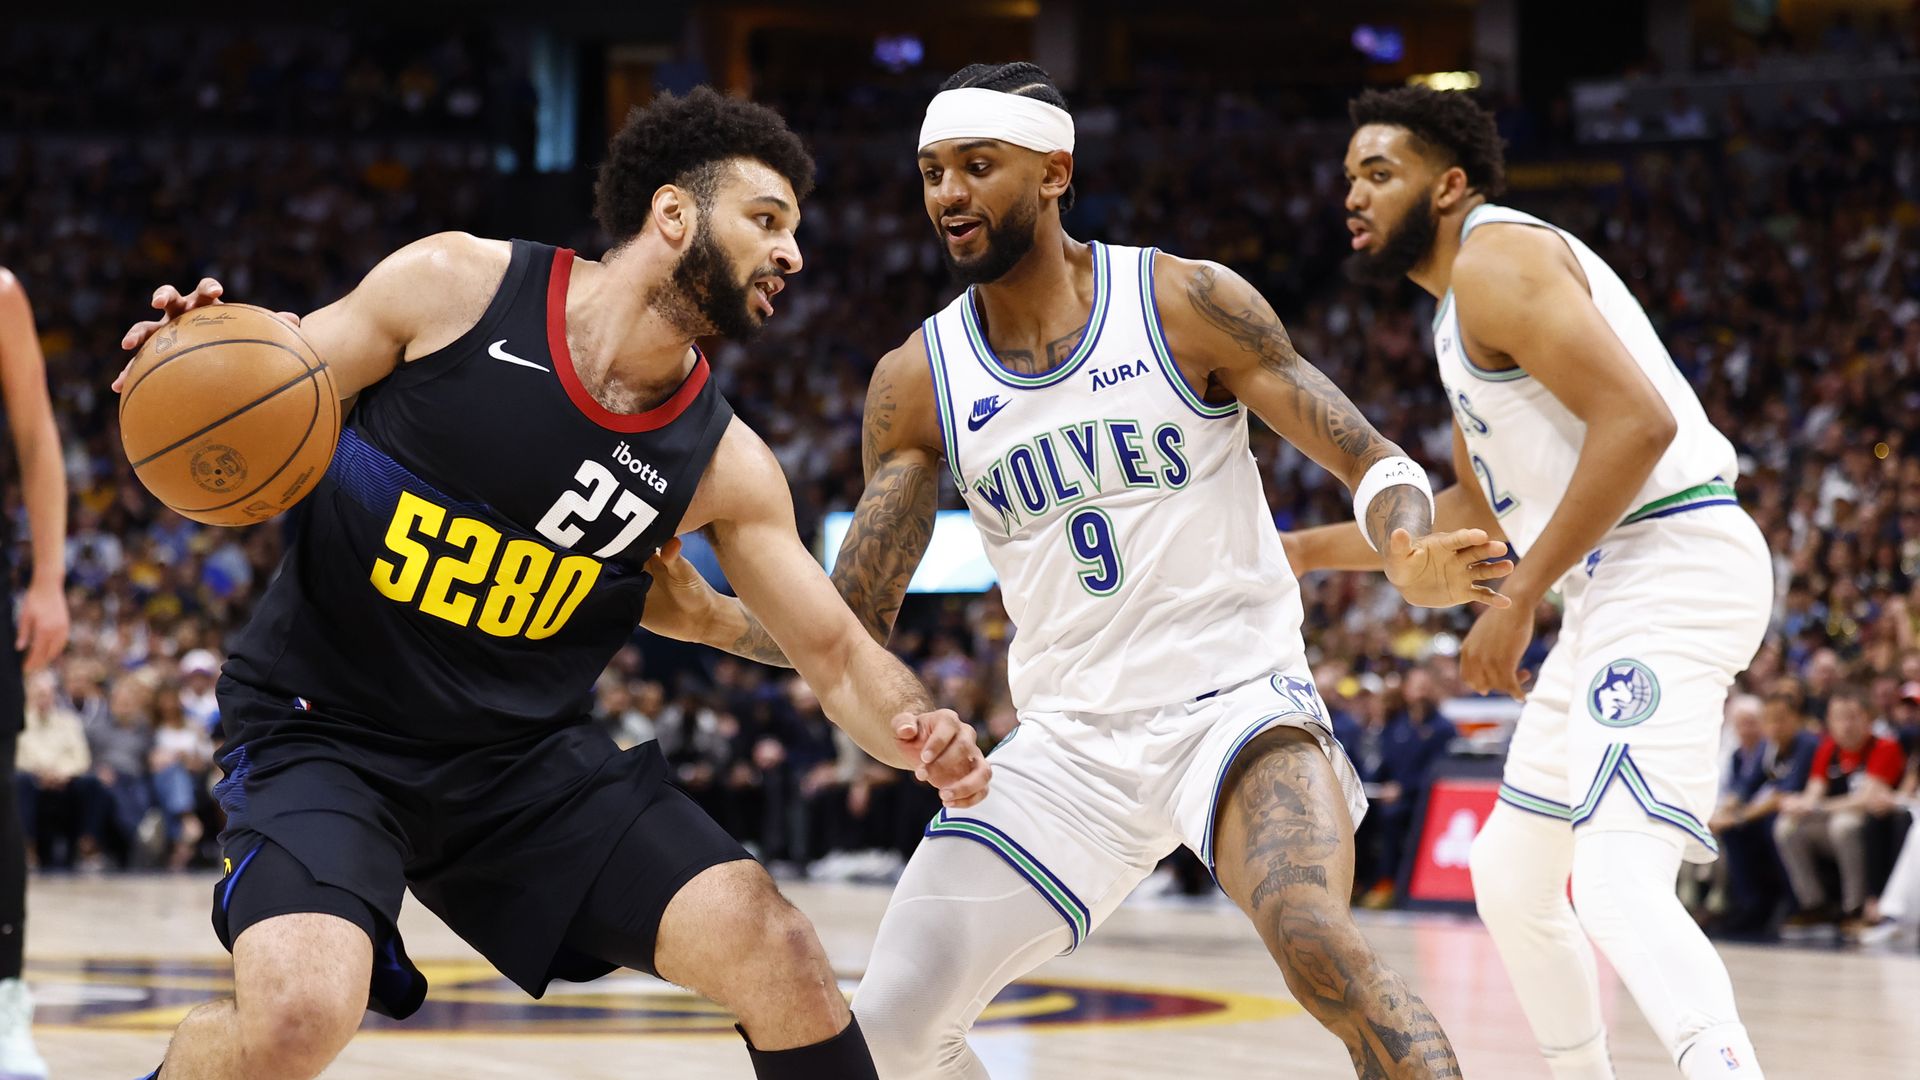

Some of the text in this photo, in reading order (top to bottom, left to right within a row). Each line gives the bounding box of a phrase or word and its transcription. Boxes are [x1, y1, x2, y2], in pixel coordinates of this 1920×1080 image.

[972, 395, 1000, 418] NIKE
[534, 459, 660, 559] 27
[611, 440, 669, 494] ibotta
[973, 418, 1191, 537] WOLVES
[369, 490, 603, 640] 5280
[1066, 505, 1125, 597] 9
